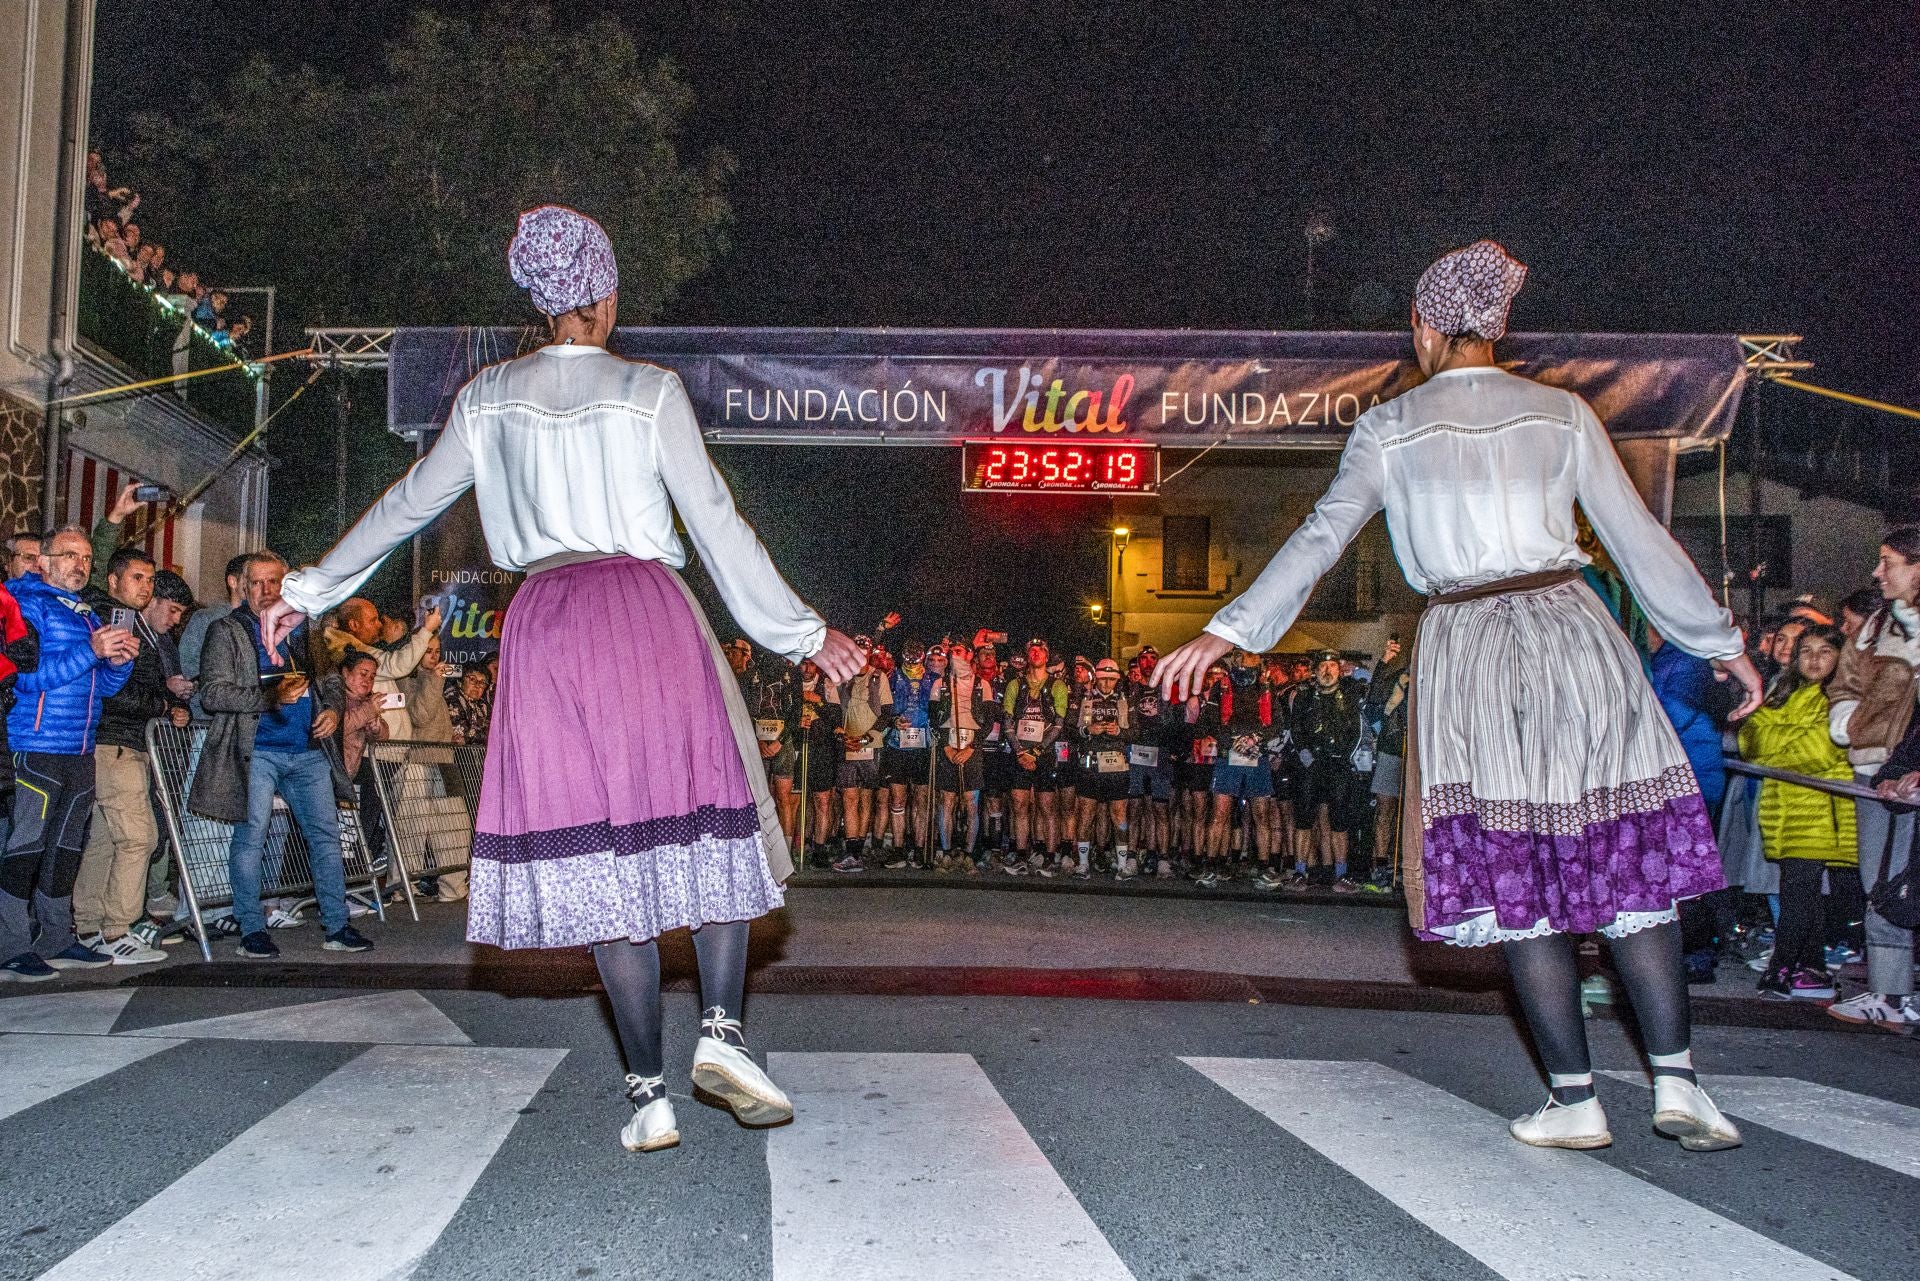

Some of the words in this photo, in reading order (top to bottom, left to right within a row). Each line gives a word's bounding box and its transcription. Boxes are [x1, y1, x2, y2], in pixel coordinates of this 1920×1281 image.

[724, 380, 947, 423] FUNDACIÓN
[974, 366, 1135, 433] Vital
[986, 450, 1136, 482] 23:52:19
[431, 568, 513, 584] FUNDACIÓN
[419, 593, 504, 639] Vita
